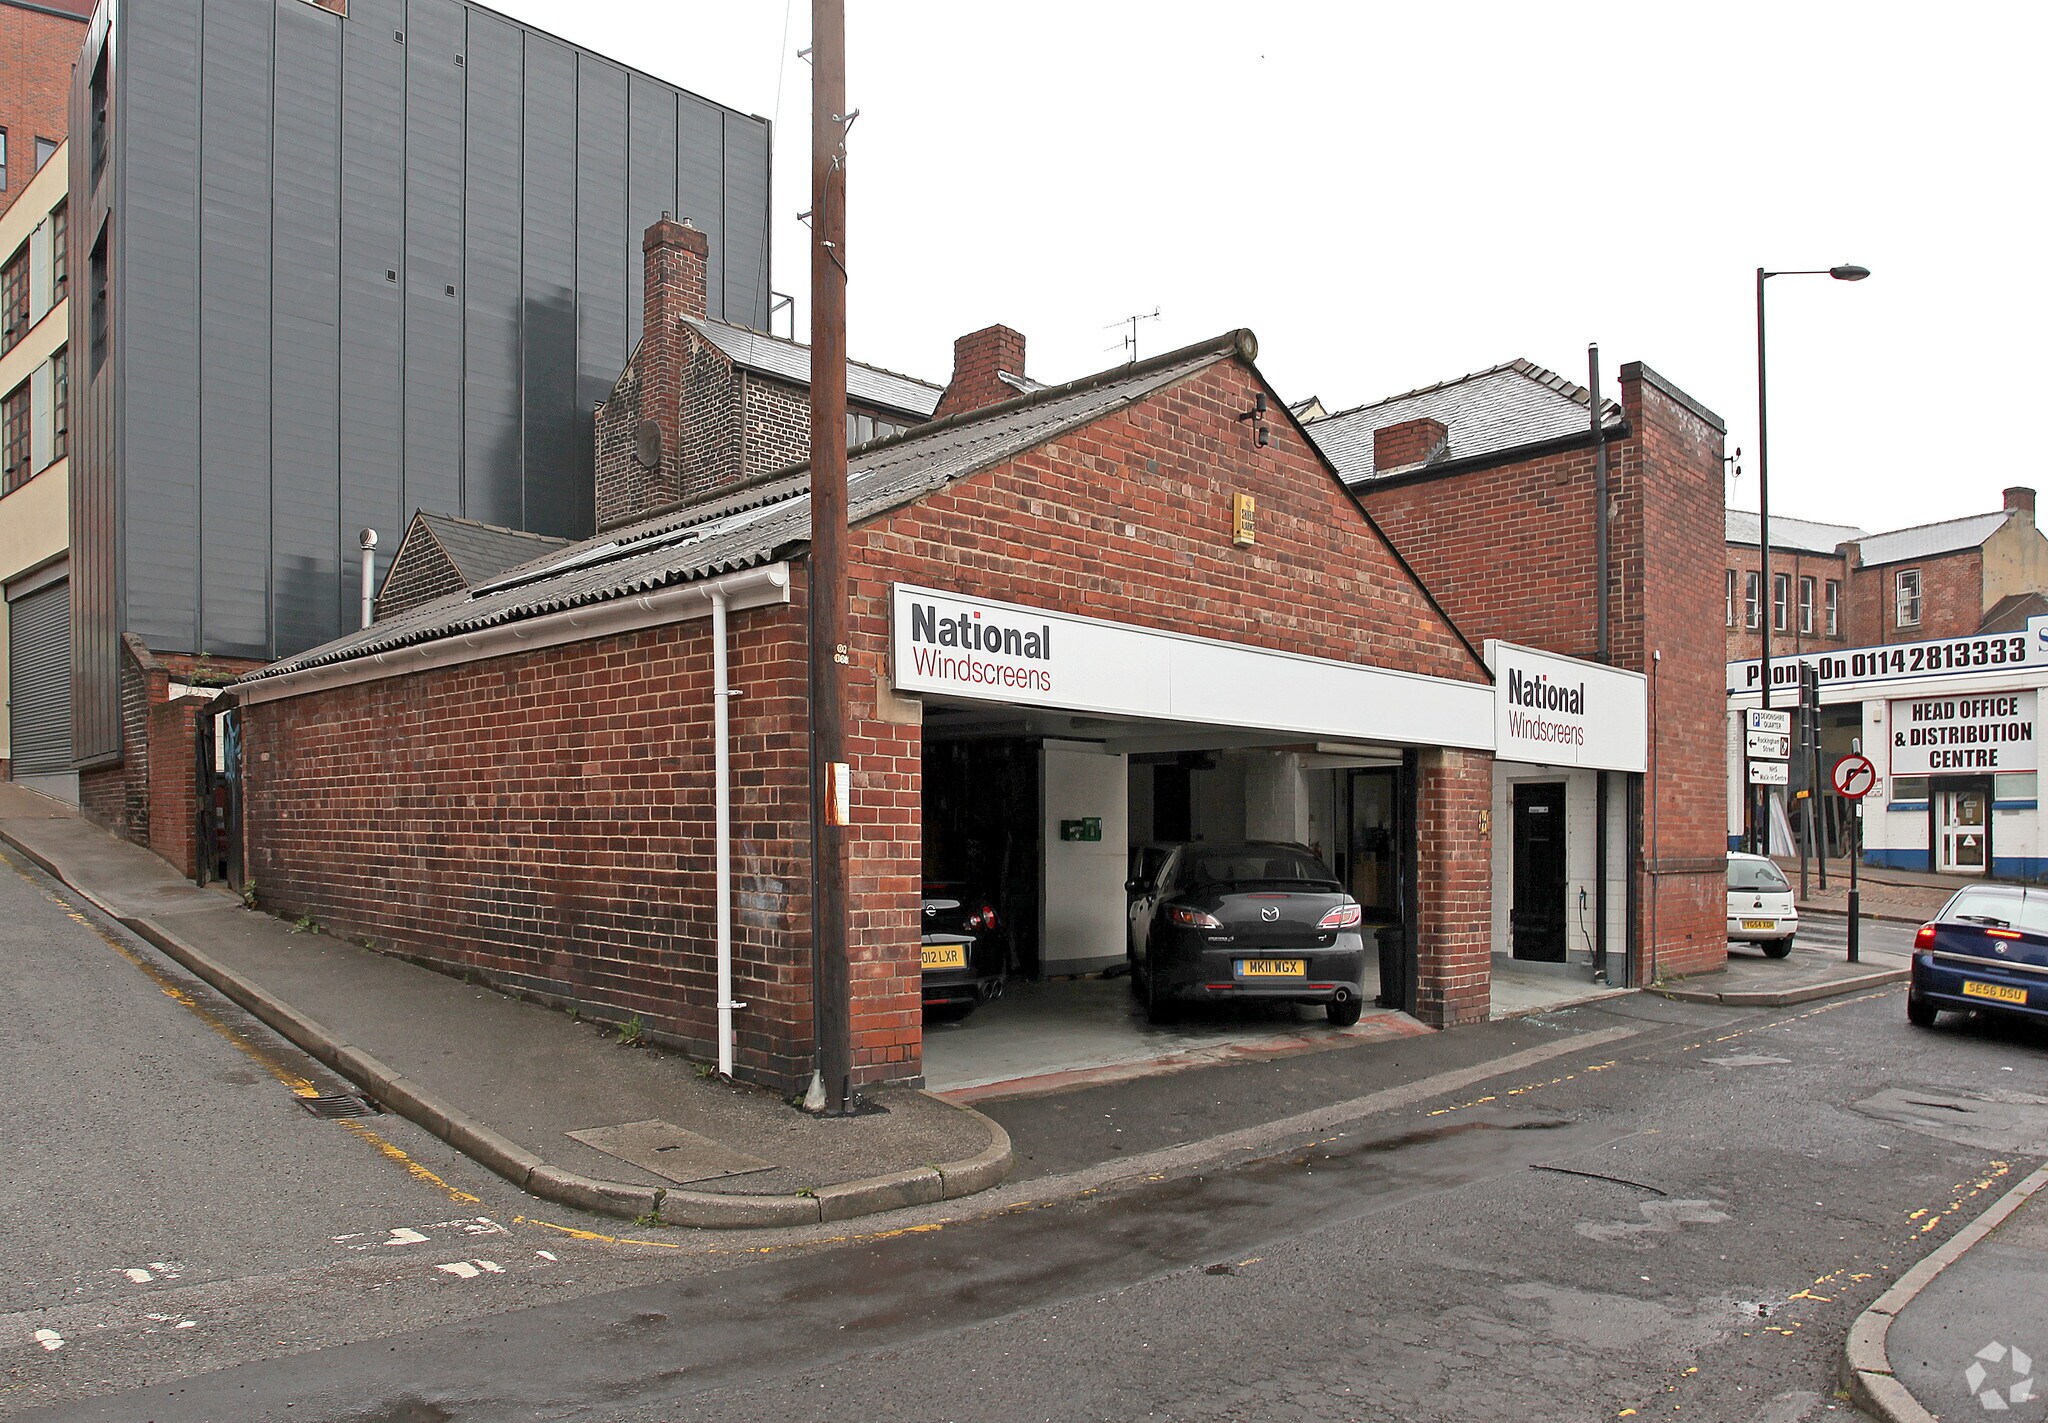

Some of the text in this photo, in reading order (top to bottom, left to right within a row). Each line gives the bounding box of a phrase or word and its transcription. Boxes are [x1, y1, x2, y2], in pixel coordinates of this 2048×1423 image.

[912, 603, 1050, 660] National
[913, 646, 1050, 691] Windscreens
[1819, 657, 1846, 679] On
[1852, 650, 1906, 677] 0114
[1909, 637, 2026, 671] 2813333
[1509, 667, 1584, 715] National
[1912, 697, 2018, 721] HEAD OFFICE
[1509, 710, 1584, 746] Windscreens
[1895, 722, 2032, 747] & DISTRIBUTION
[1929, 749, 1998, 768] CENTRE
[939, 950, 958, 963] LXR
[1250, 961, 1297, 973] MK11 WGX
[1969, 982, 2021, 999] SE56 DSU
